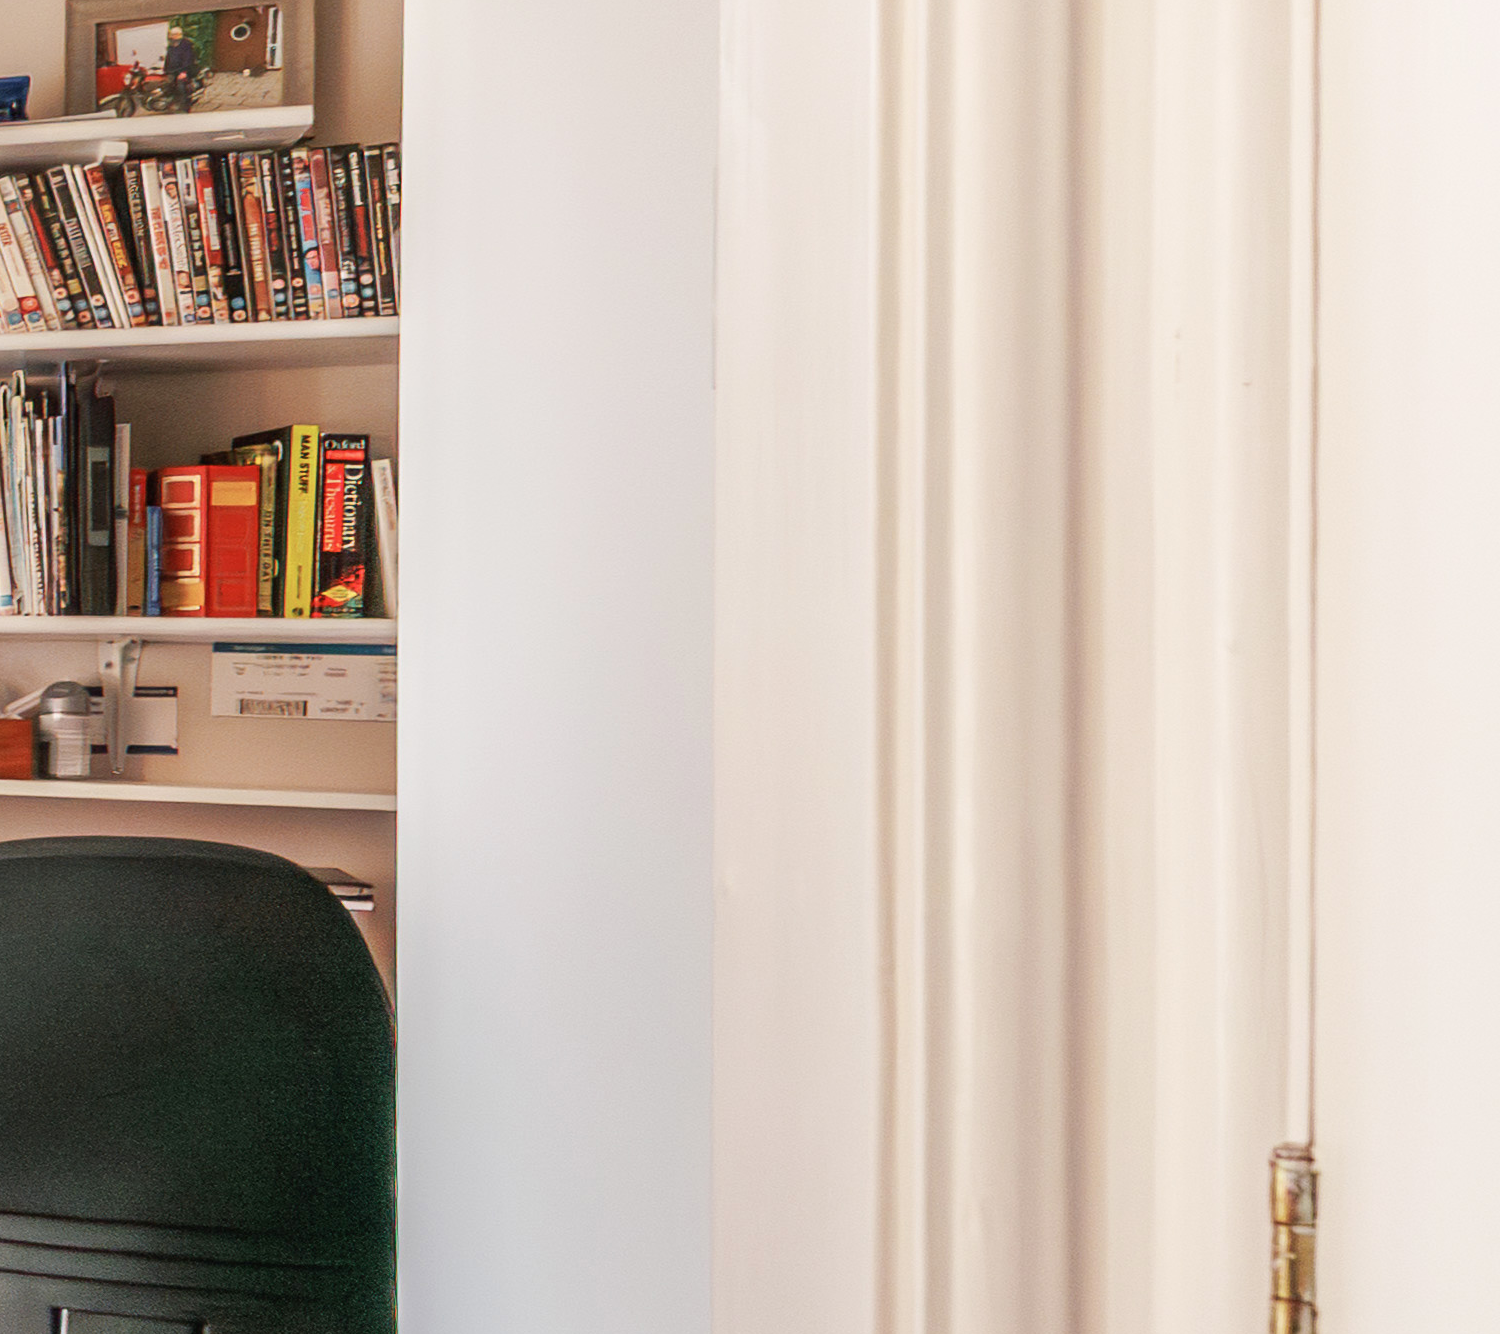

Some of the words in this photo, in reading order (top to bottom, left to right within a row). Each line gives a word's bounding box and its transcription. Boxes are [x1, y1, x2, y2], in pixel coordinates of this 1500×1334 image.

[301, 434, 312, 456] MAN
[325, 438, 366, 450] Oxford
[298, 458, 311, 494] STUFF
[323, 475, 342, 552] Thesaurus
[341, 463, 365, 551] Dictionary
